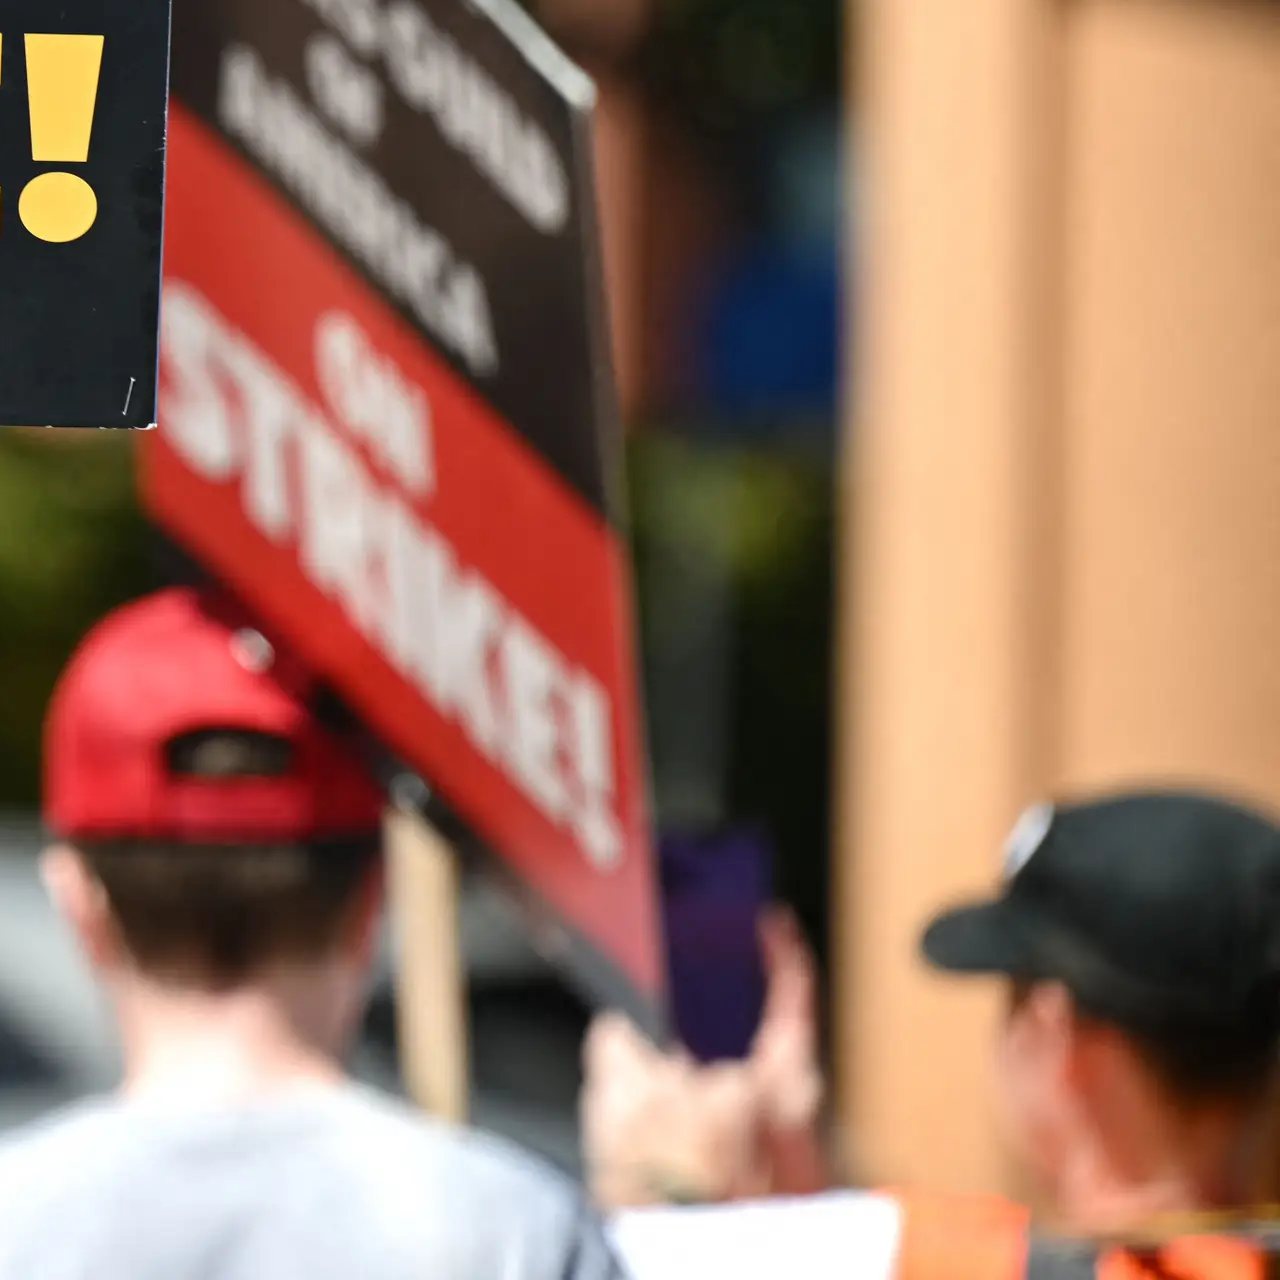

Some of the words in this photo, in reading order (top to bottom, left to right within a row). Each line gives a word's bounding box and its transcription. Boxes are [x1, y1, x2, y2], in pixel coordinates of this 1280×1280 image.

[217, 45, 498, 378] AMERICA
[305, 32, 383, 150] OF
[313, 308, 435, 502] ON
[156, 275, 625, 875] STRIKE!
